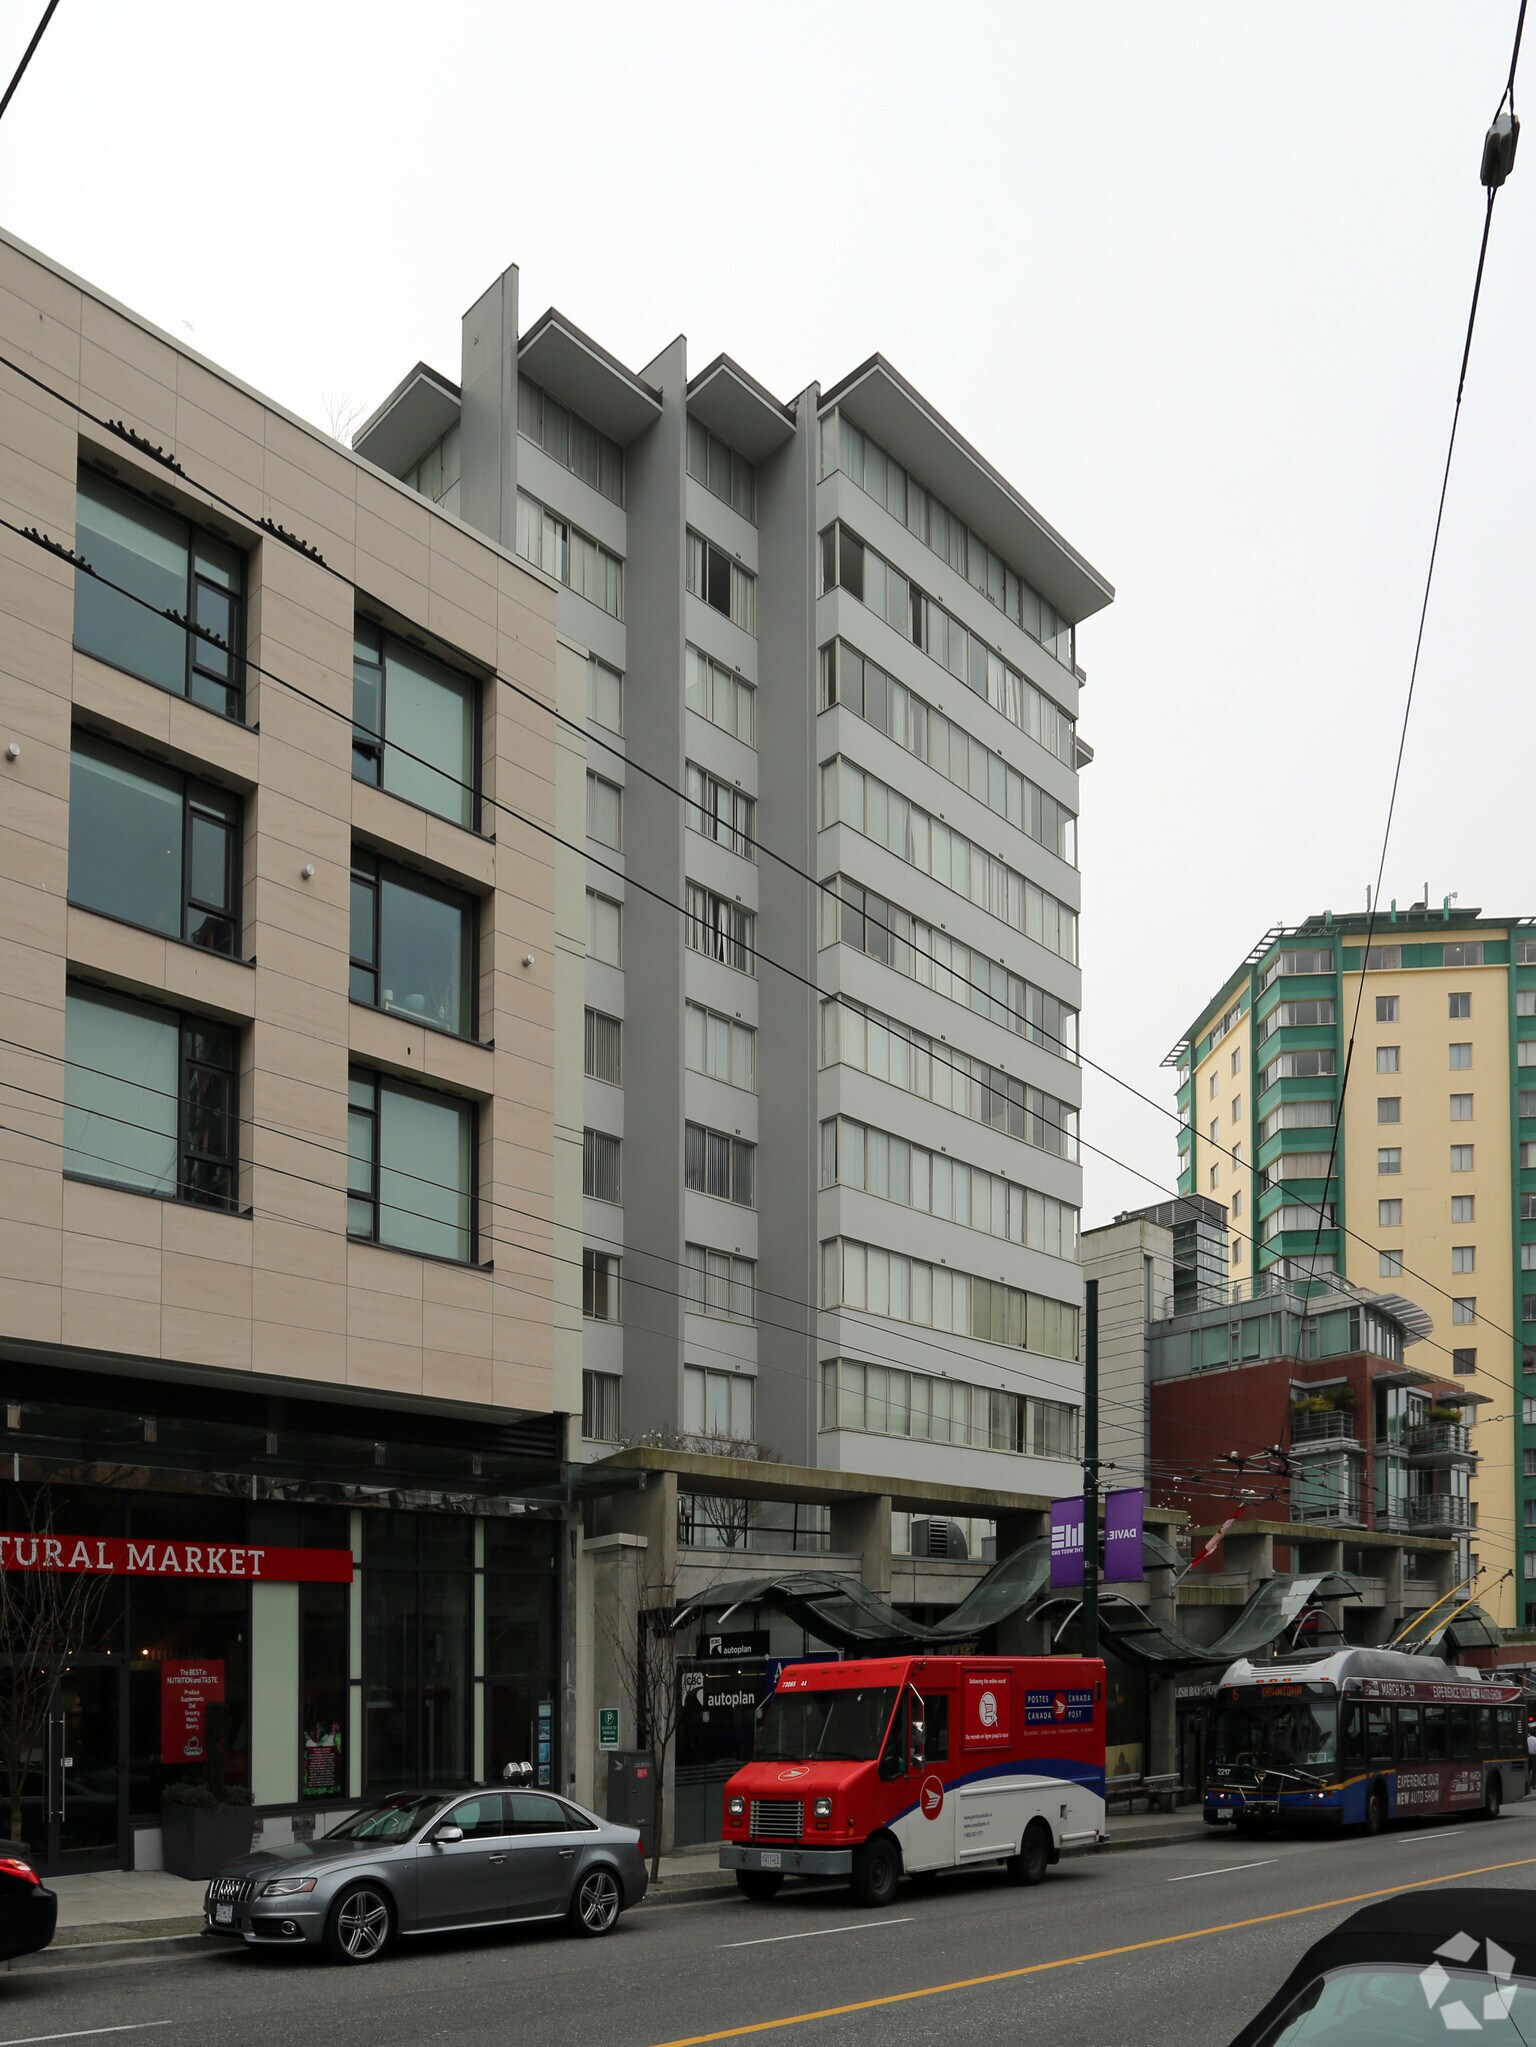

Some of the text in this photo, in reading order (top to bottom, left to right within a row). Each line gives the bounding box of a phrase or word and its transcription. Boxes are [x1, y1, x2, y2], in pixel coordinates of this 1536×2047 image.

[127, 1544, 265, 1575] MARKET
[723, 1645, 751, 1654] autoplan
[1190, 1686, 1201, 1697] BAY
[1381, 1683, 1400, 1696] MARCH
[1400, 1684, 1407, 1697] 24
[1433, 1685, 1460, 1698] EXPERIENCE
[1460, 1687, 1471, 1699] YOUR
[1471, 1688, 1480, 1699] NEW
[707, 1690, 755, 1708] autoplan
[1028, 1694, 1091, 1704] POSTES CANADA
[607, 1713, 613, 1723] P
[1028, 1710, 1082, 1720] CANADA POST
[1217, 1768, 1231, 1776] 2217
[1398, 1773, 1439, 1789] EXPERIENCE YOUR
[1396, 1791, 1409, 1806] NEW
[1410, 1790, 1424, 1804] AUTO
[1424, 1789, 1439, 1803] SHOW
